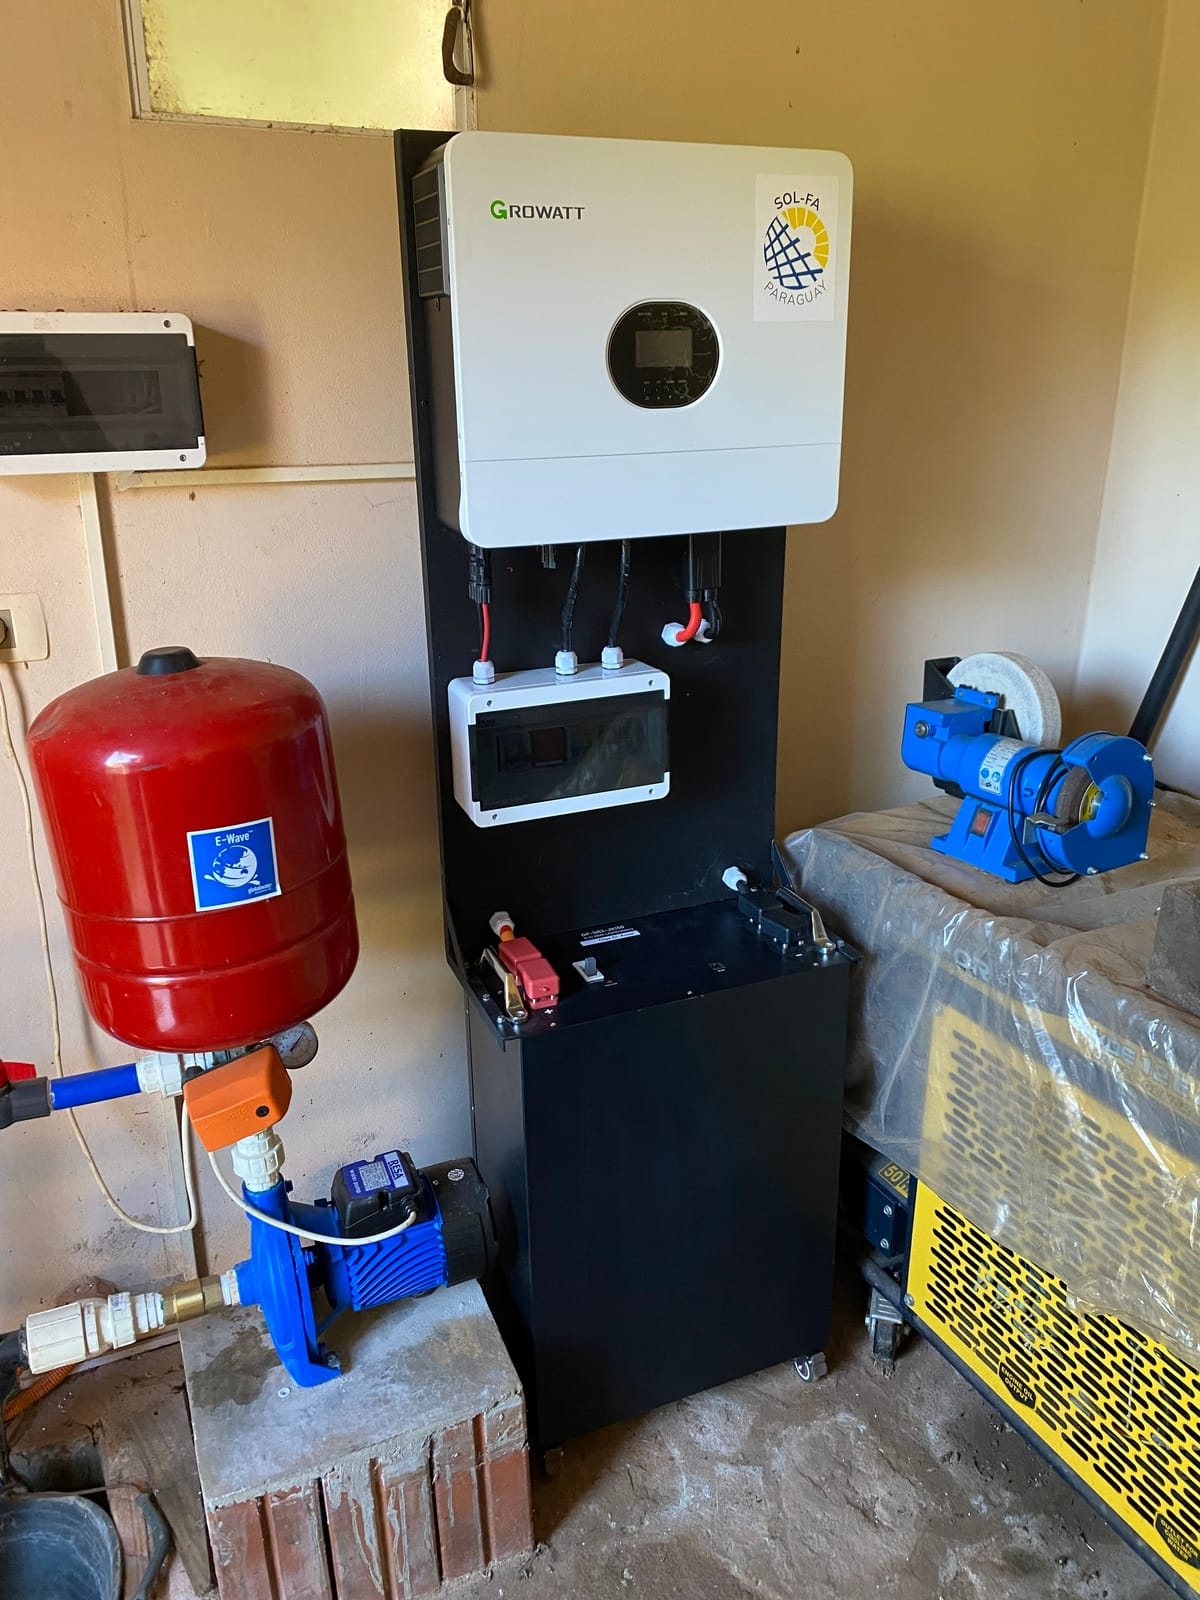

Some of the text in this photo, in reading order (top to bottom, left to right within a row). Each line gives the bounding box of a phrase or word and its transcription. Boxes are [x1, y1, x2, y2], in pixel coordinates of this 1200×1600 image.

[490, 199, 585, 220] GROWATT
[774, 191, 821, 211] SOL-FA
[764, 280, 826, 306] PARAGUAY
[215, 832, 250, 847] E-Wave
[388, 1159, 405, 1181] RESA
[1001, 1366, 1023, 1391] ENGINE
[1004, 1377, 1029, 1403] OUTPUT
